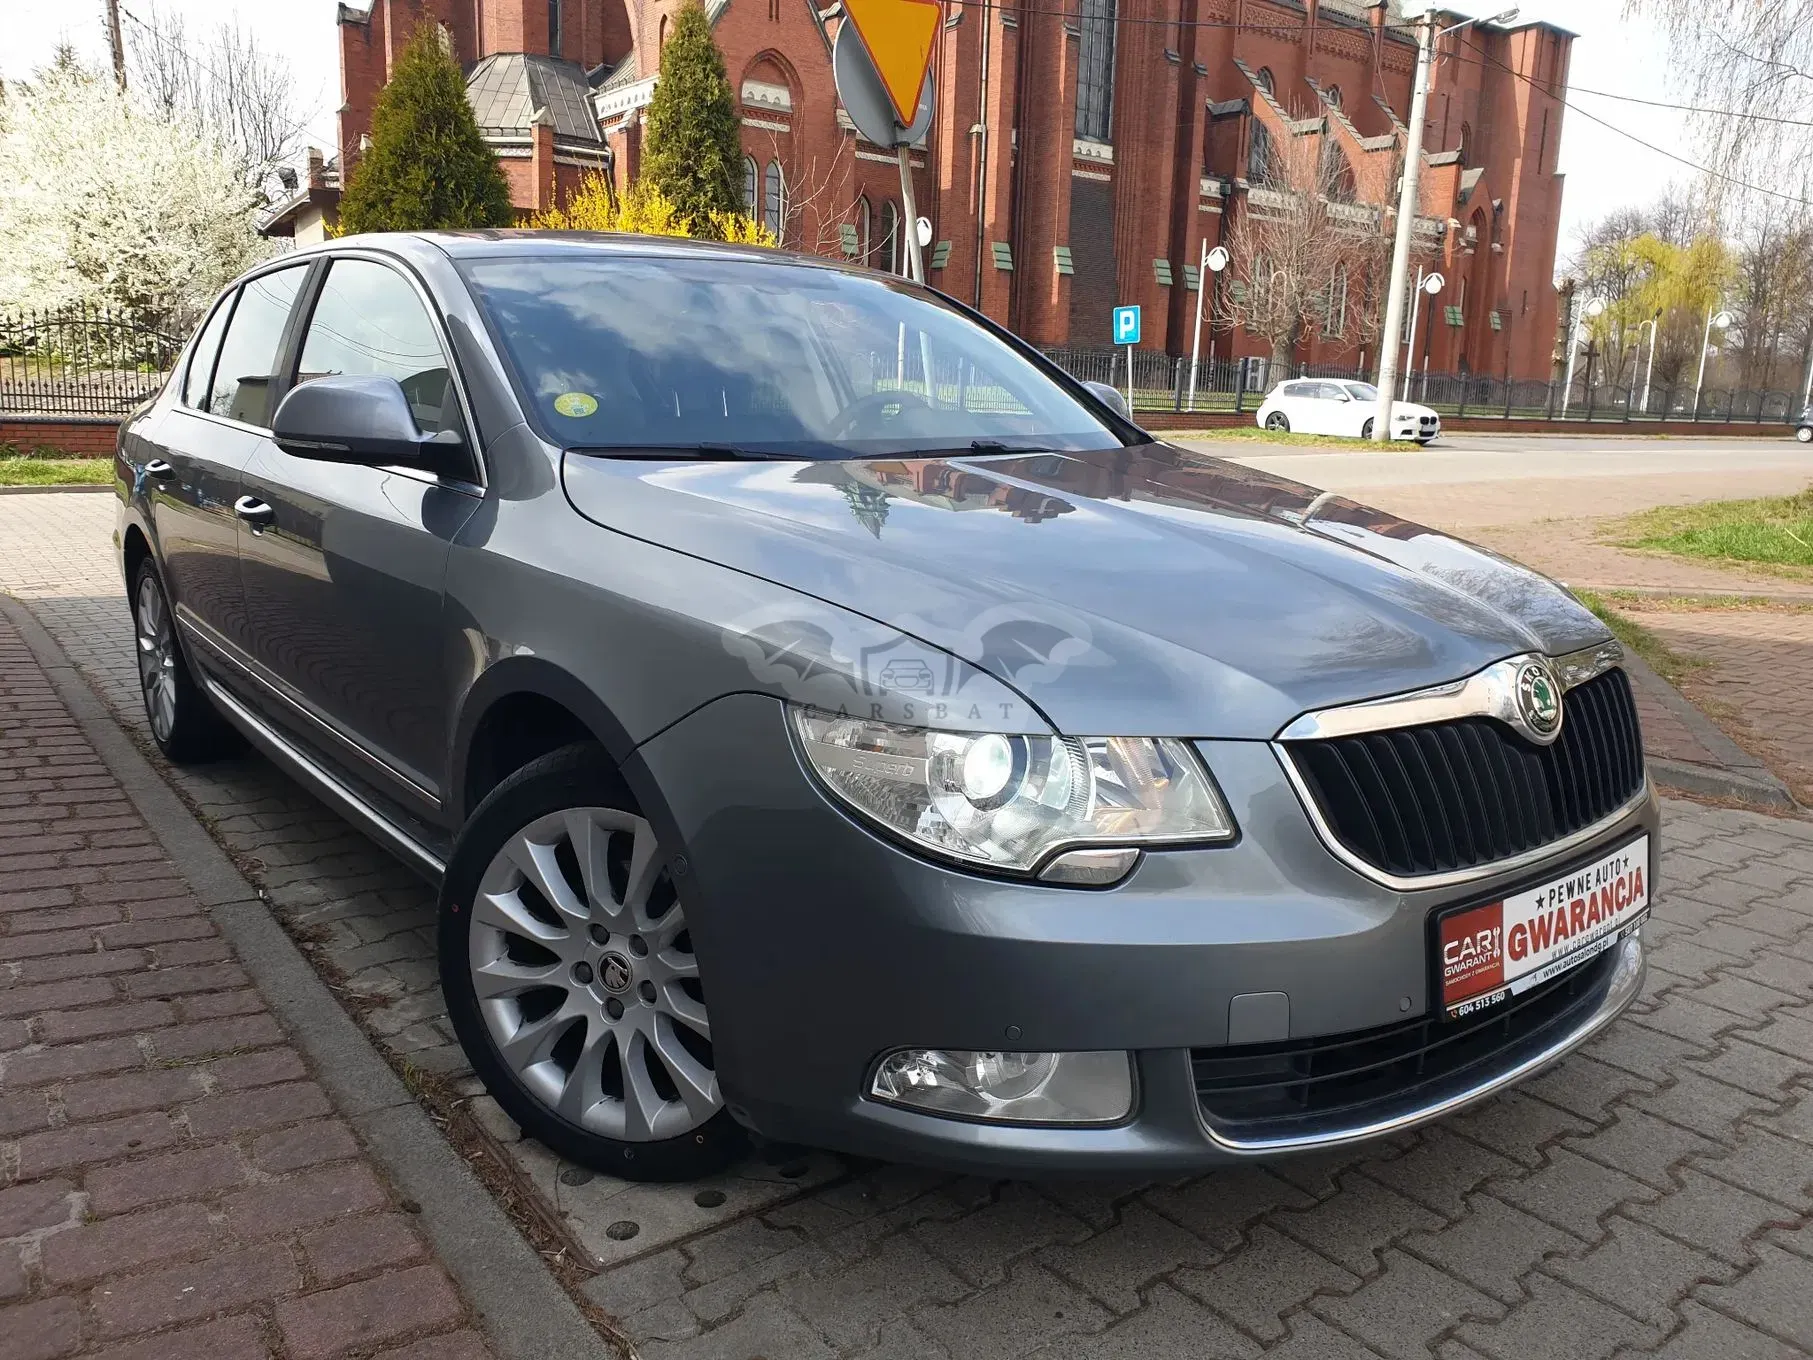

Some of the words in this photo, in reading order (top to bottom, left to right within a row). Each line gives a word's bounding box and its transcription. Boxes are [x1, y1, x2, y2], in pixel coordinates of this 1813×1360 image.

[1120, 310, 1135, 340] P
[1548, 872, 1591, 907] PEWNE
[1595, 858, 1621, 888] AUTO
[1507, 866, 1645, 962] GWARANCJA
[1444, 929, 1492, 965] CAR
[1444, 951, 1492, 977] GWARANT
[1543, 936, 1609, 979] www.autosalondg.pl
[1458, 1003, 1474, 1016] 604
[1475, 996, 1490, 1010] 513
[1491, 991, 1505, 1004] 560
